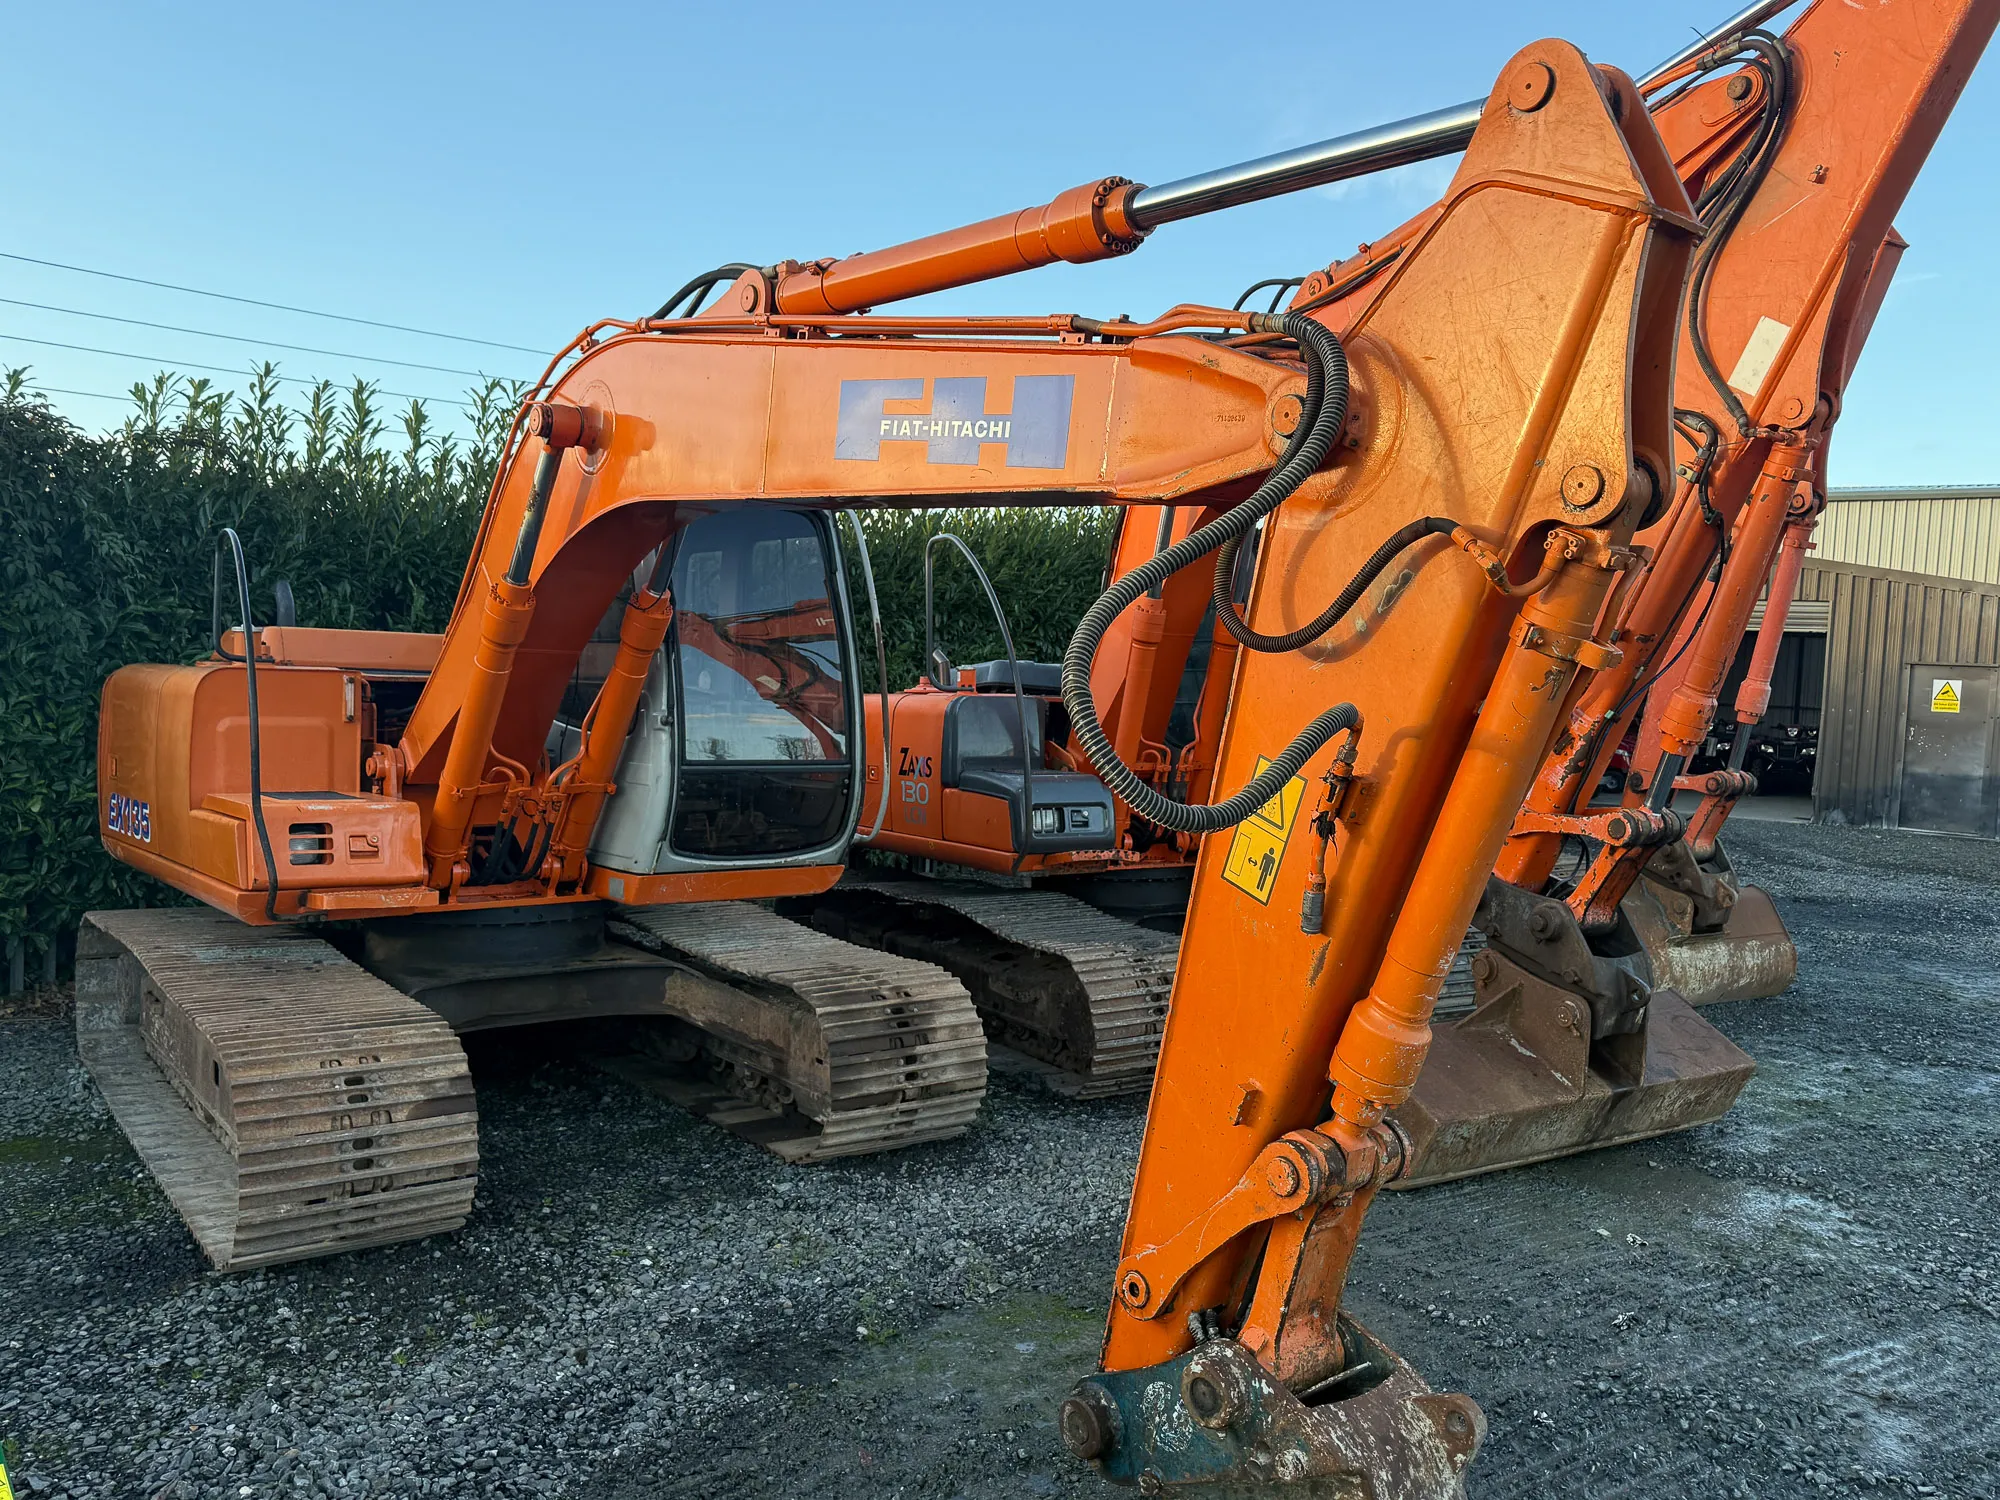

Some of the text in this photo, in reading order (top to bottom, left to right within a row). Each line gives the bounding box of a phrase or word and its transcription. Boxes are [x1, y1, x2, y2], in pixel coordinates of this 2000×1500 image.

[879, 420, 1012, 438] FIAT-HITACHI
[898, 747, 933, 780] ZAXIS
[901, 780, 929, 805] 130
[108, 792, 151, 843] EX135
